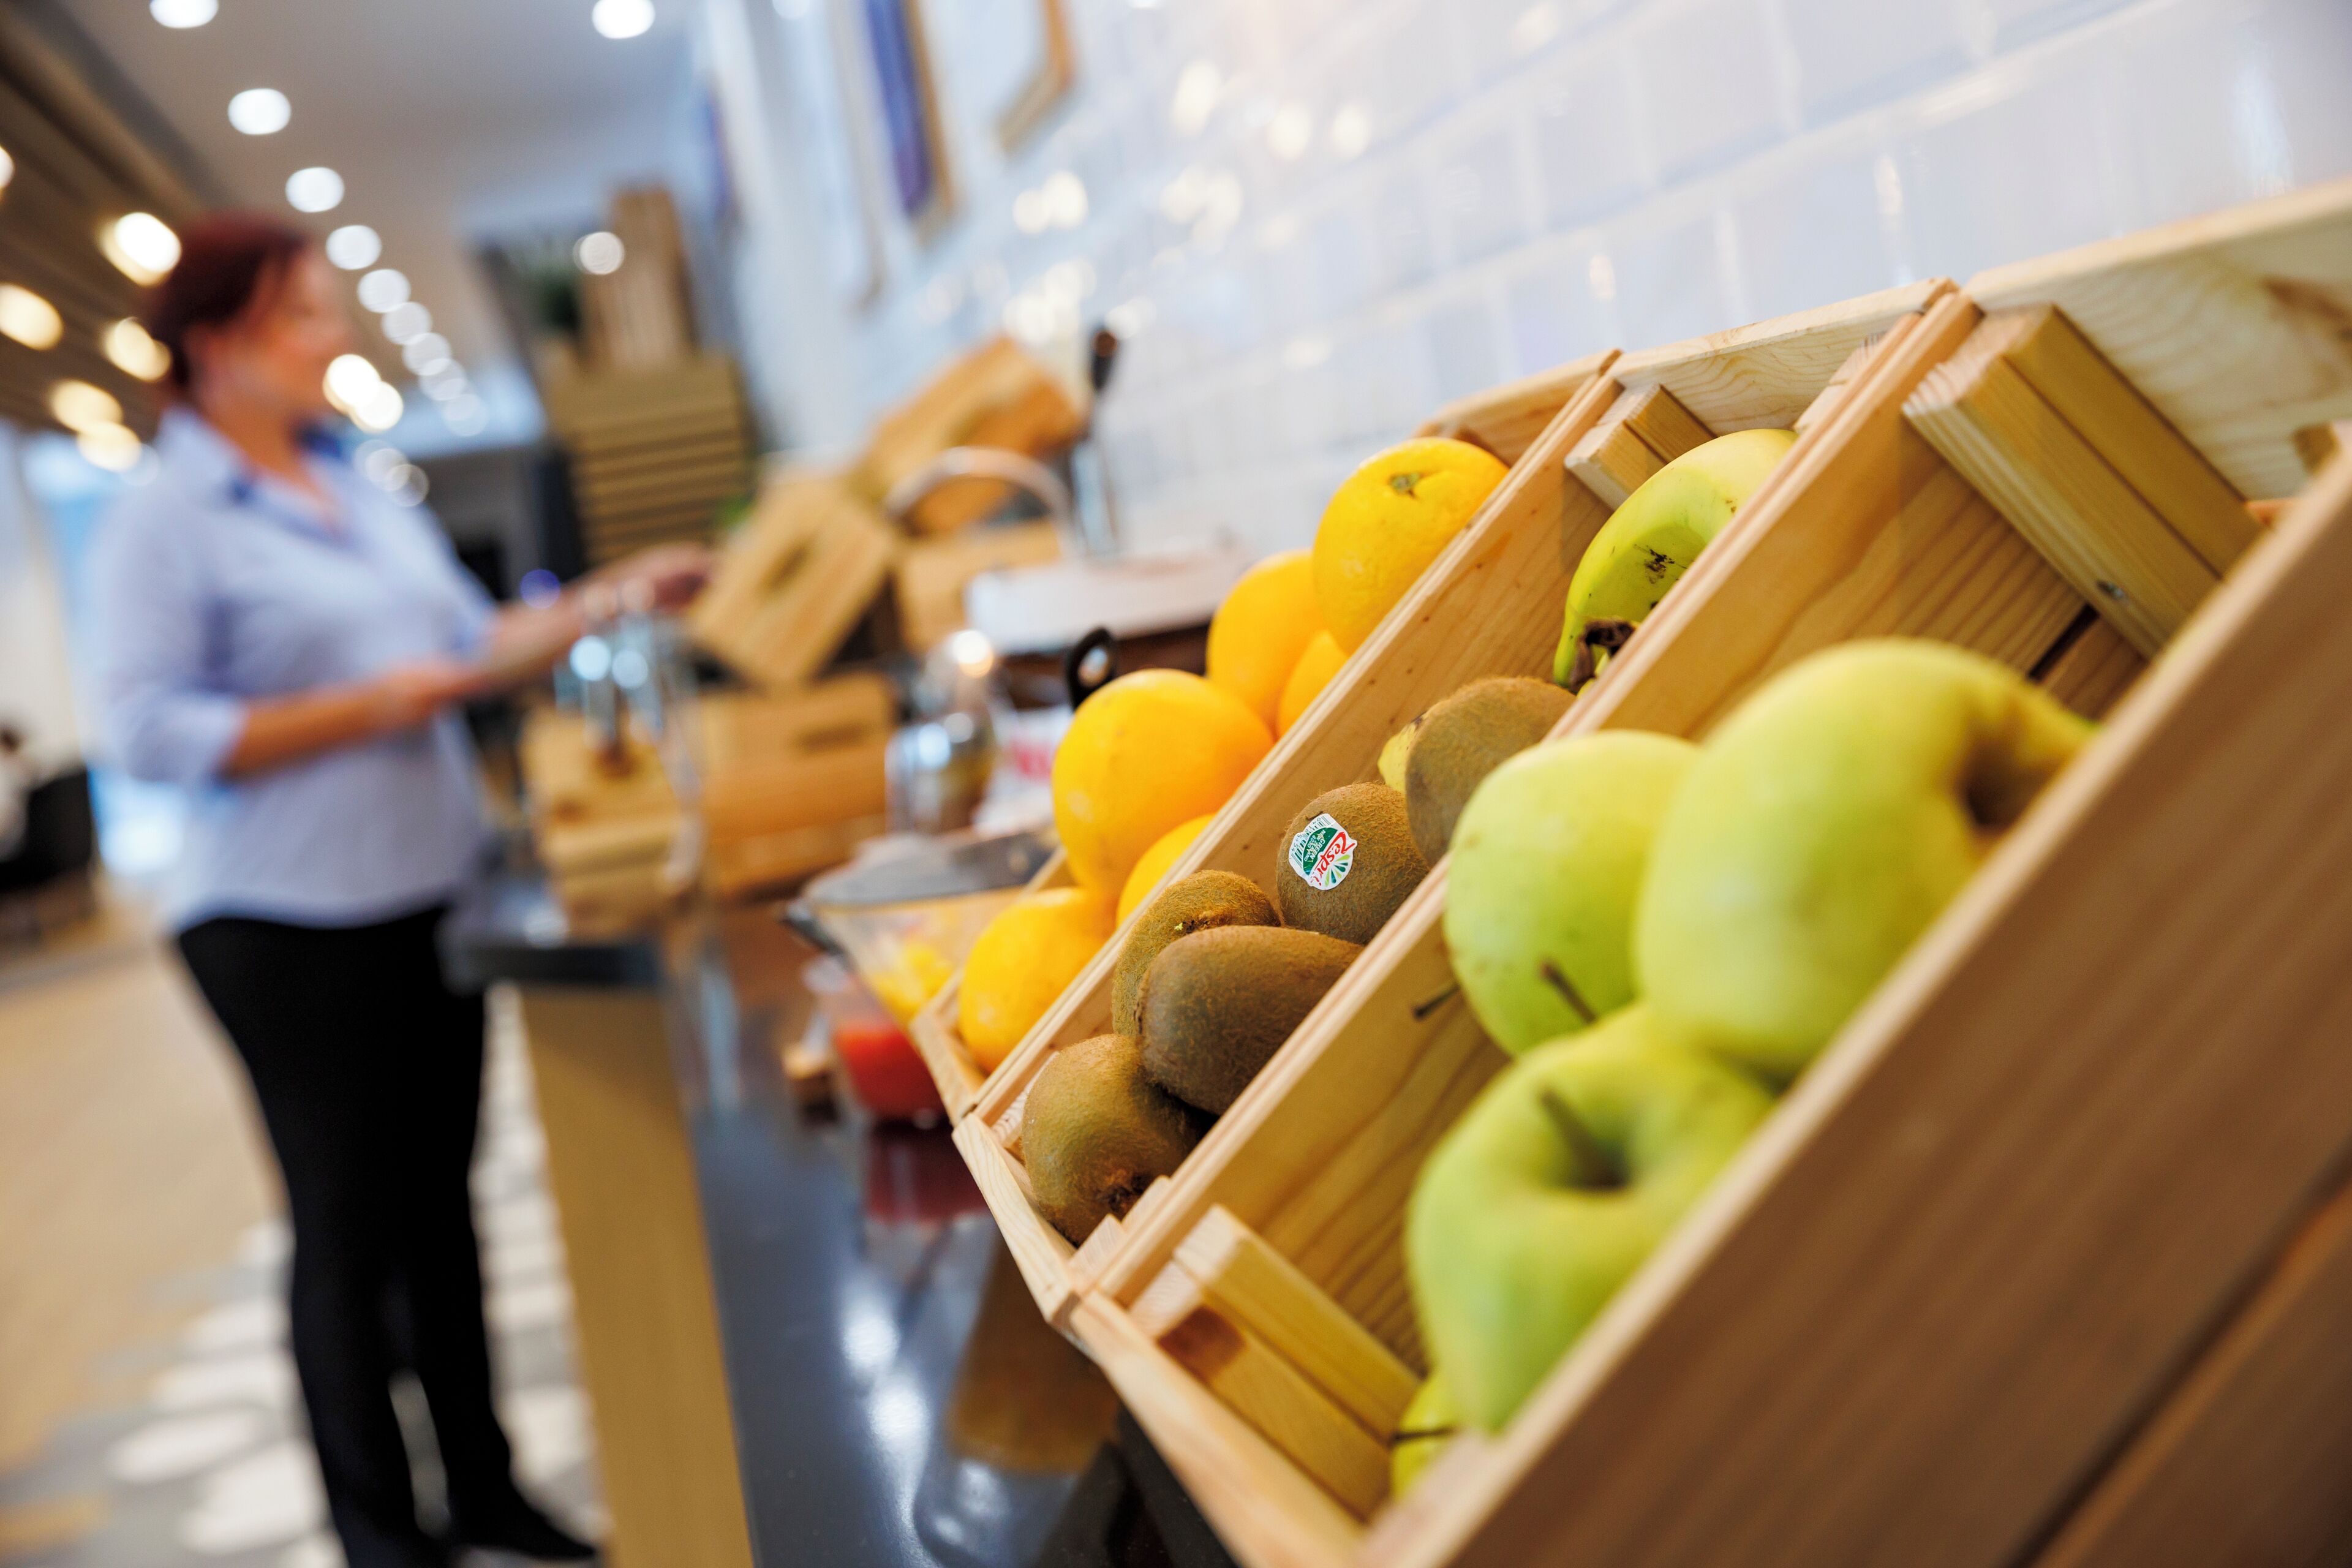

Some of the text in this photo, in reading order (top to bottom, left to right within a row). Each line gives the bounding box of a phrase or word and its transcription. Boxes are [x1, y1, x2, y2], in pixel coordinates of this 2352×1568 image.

[1303, 829, 1327, 862] NEW ZEALAND
[1310, 839, 1326, 860] GREEN
[1313, 832, 1355, 886] Zespri
